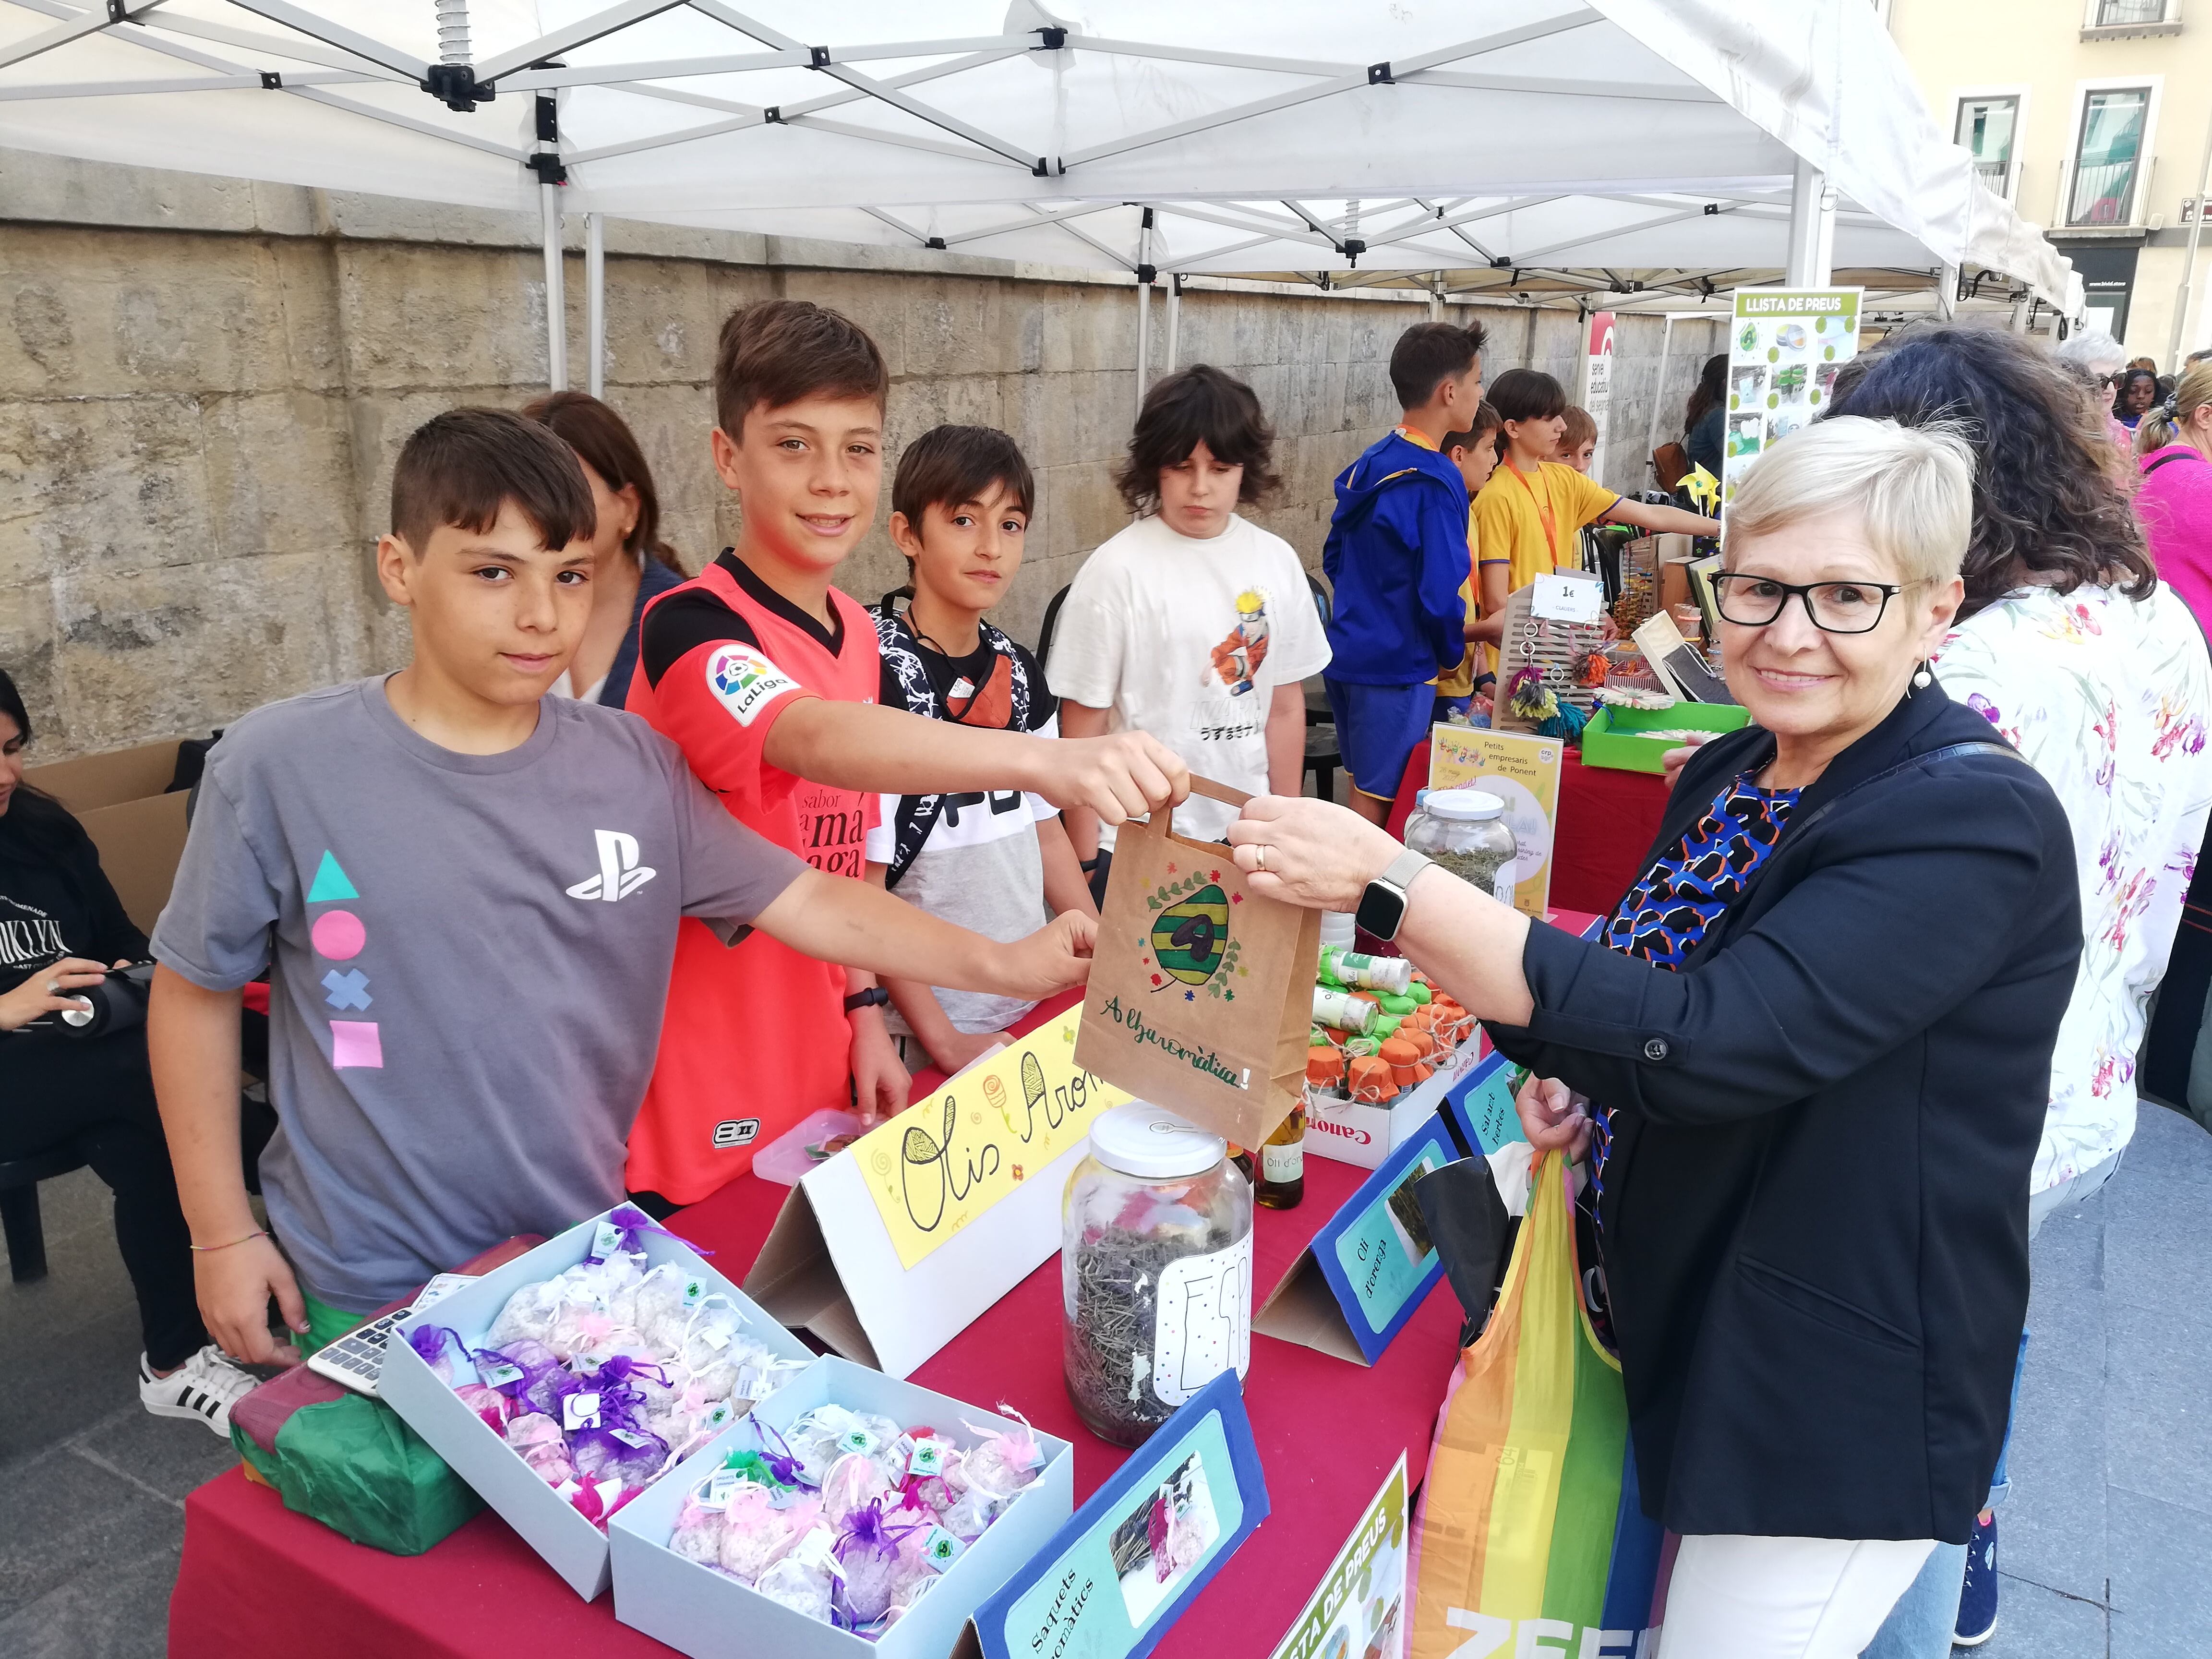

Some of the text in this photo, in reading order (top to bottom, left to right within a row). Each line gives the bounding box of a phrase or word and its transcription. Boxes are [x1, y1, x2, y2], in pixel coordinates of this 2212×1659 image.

[1746, 297, 1841, 312] LLISTA DE PREUS
[1591, 361, 1604, 376] servei
[1590, 377, 1609, 394] educatiu
[737, 679, 789, 714] LaLiga
[1484, 742, 1504, 750] Petits
[1489, 754, 1528, 764] empresaris
[1510, 766, 1536, 776] Ponent
[802, 789, 841, 808] sabor
[799, 814, 810, 831] a
[1481, 1091, 1495, 1136] Sal amb
[1305, 1117, 1371, 1145] Canon
[1492, 1106, 1505, 1146] herbes
[902, 1095, 999, 1232] Olis
[1267, 1157, 1280, 1167] Oli
[1357, 1238, 1369, 1261] Oli
[1365, 1239, 1387, 1299] d'orenga
[1324, 1575, 1343, 1624] DE
[1345, 1507, 1386, 1588] PREUS
[1032, 1568, 1076, 1655] Saquets
